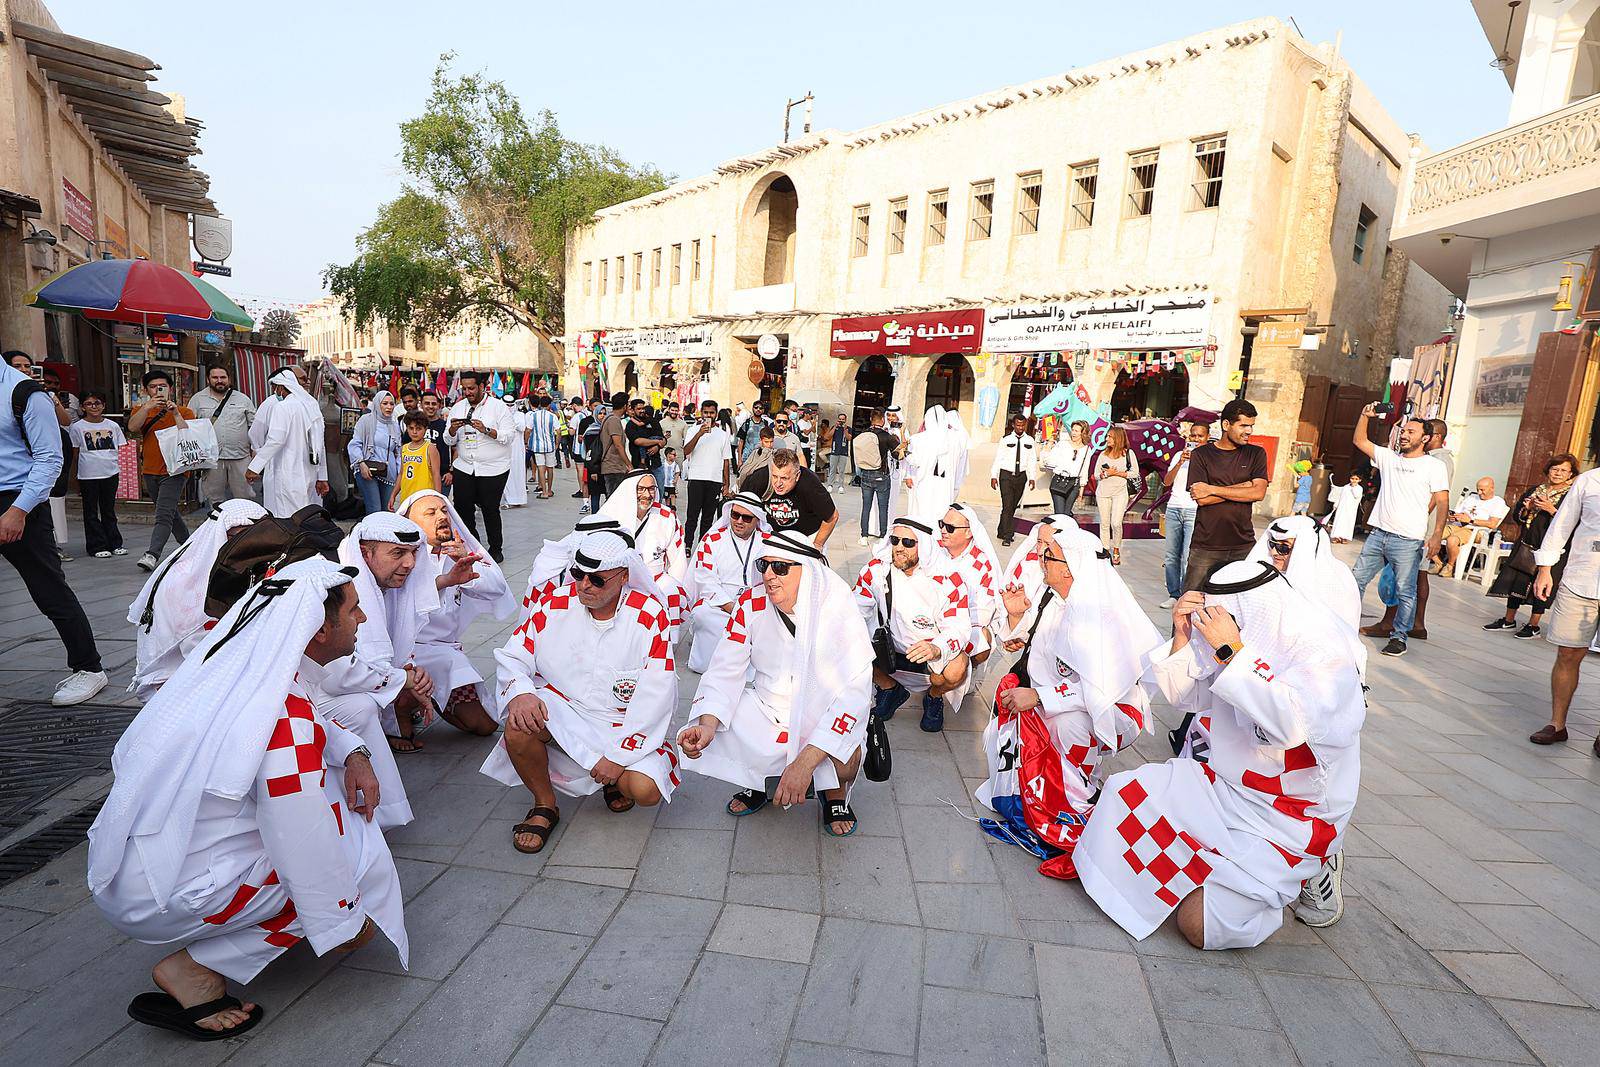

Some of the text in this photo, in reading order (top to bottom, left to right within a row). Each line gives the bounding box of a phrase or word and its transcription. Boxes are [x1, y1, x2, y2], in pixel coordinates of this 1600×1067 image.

[988, 297, 1206, 327] متجر الخليفي والقحطاني
[1026, 324, 1076, 334] QAHTANI
[1093, 320, 1152, 331] KHELAIFI
[423, 429, 439, 440] AP
[184, 453, 199, 464] YOU
[407, 465, 414, 479] 6
[772, 509, 800, 519] HRVATI
[831, 804, 850, 814] FILA
